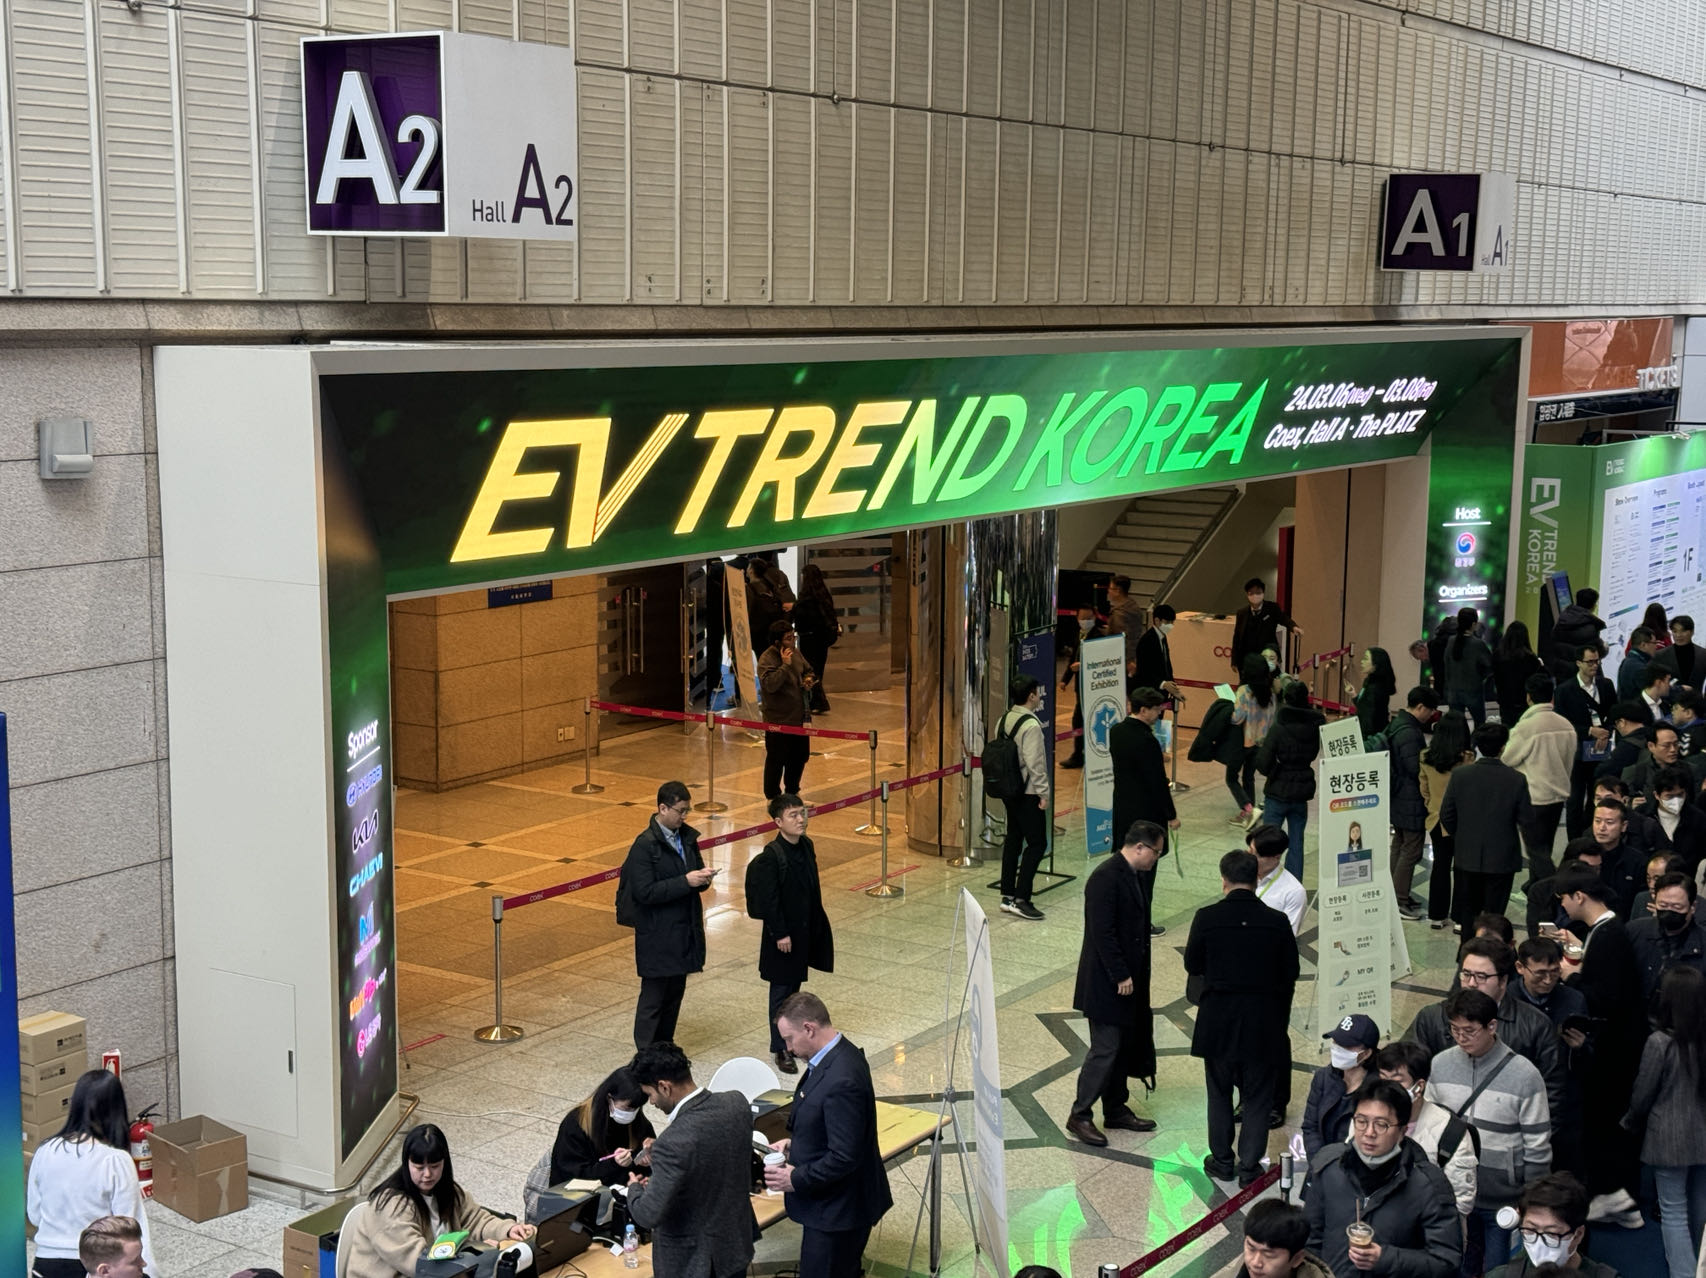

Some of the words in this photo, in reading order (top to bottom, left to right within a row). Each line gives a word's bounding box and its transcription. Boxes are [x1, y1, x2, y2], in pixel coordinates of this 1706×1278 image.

[316, 71, 441, 205] A2
[472, 199, 507, 223] Hall
[511, 143, 574, 227] A2
[1391, 188, 1470, 257] A1
[1491, 224, 1509, 266] A1
[1264, 422, 1306, 450] Coex,
[450, 413, 690, 563] EV
[674, 394, 1027, 535] TREND
[1013, 378, 1269, 492] KOREA
[1455, 507, 1481, 520] Host
[1530, 477, 1561, 529] EV
[1526, 529, 1541, 584] KOREA
[1683, 547, 1694, 573] 1F
[1438, 584, 1488, 598] Organizers
[1086, 656, 1122, 670] International
[1092, 668, 1117, 680] Certified
[1090, 679, 1119, 691] Exhibition
[348, 719, 378, 759] Sponsor
[1328, 734, 1358, 758] 현장등록
[1330, 770, 1380, 794] 현장등록
[349, 852, 383, 898] CHAEVI
